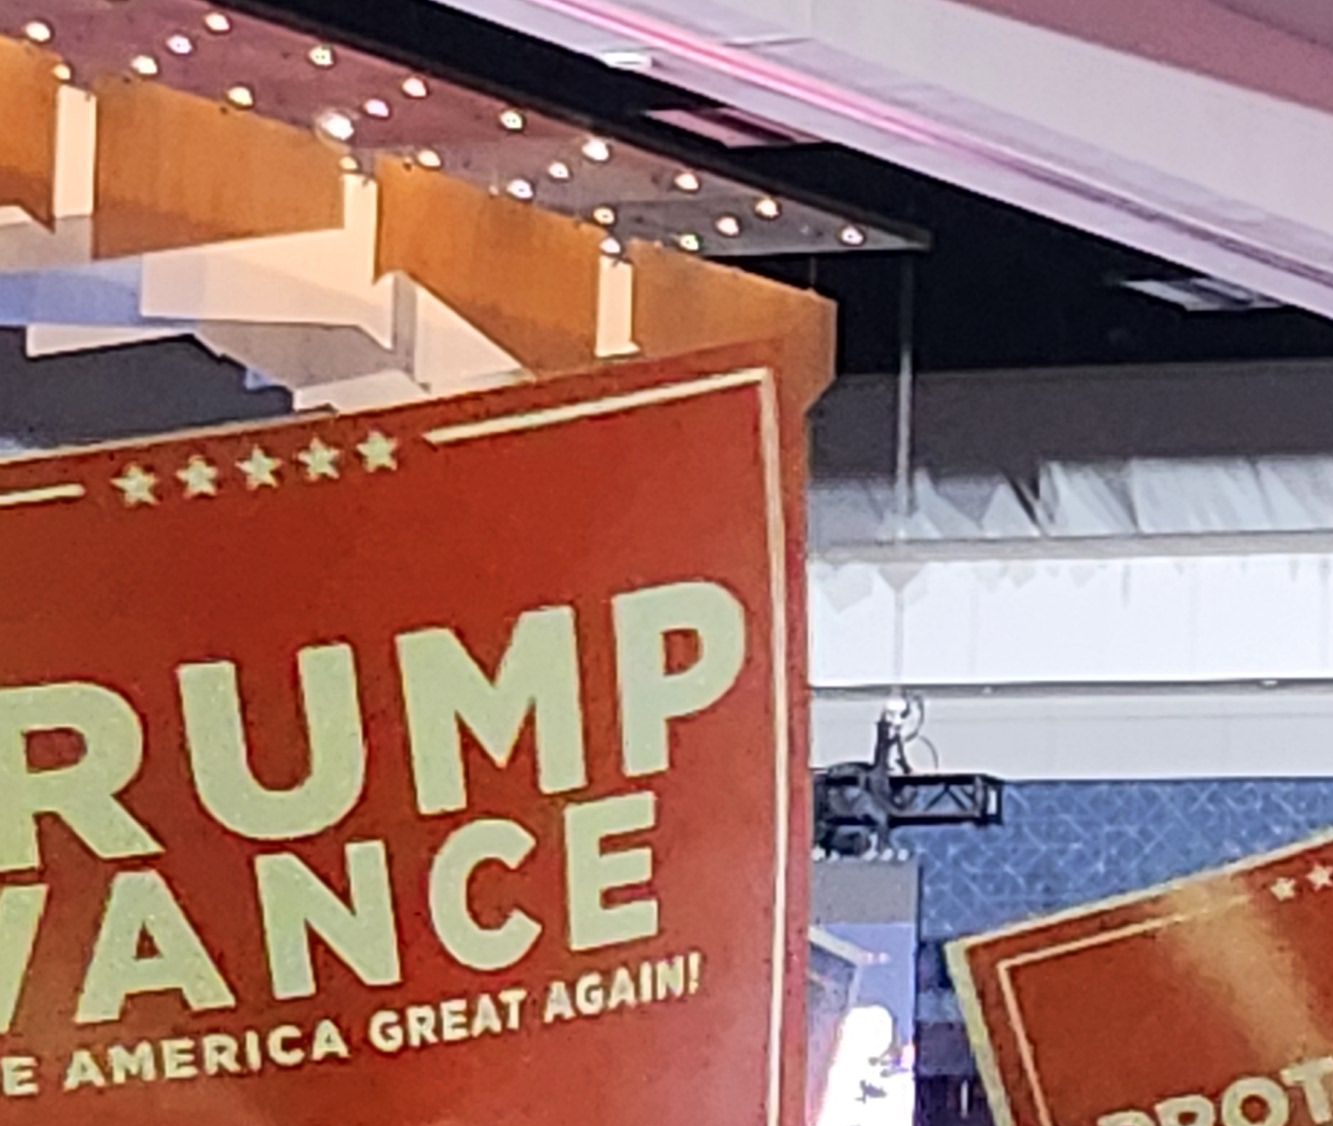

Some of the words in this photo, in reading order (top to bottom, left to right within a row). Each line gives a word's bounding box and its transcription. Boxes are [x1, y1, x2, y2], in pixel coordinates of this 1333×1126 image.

[0, 581, 745, 872] RUMP
[64, 1019, 349, 1091] AMERICA
[369, 989, 527, 1052] GREAT
[544, 952, 701, 1025] AGAIN!
